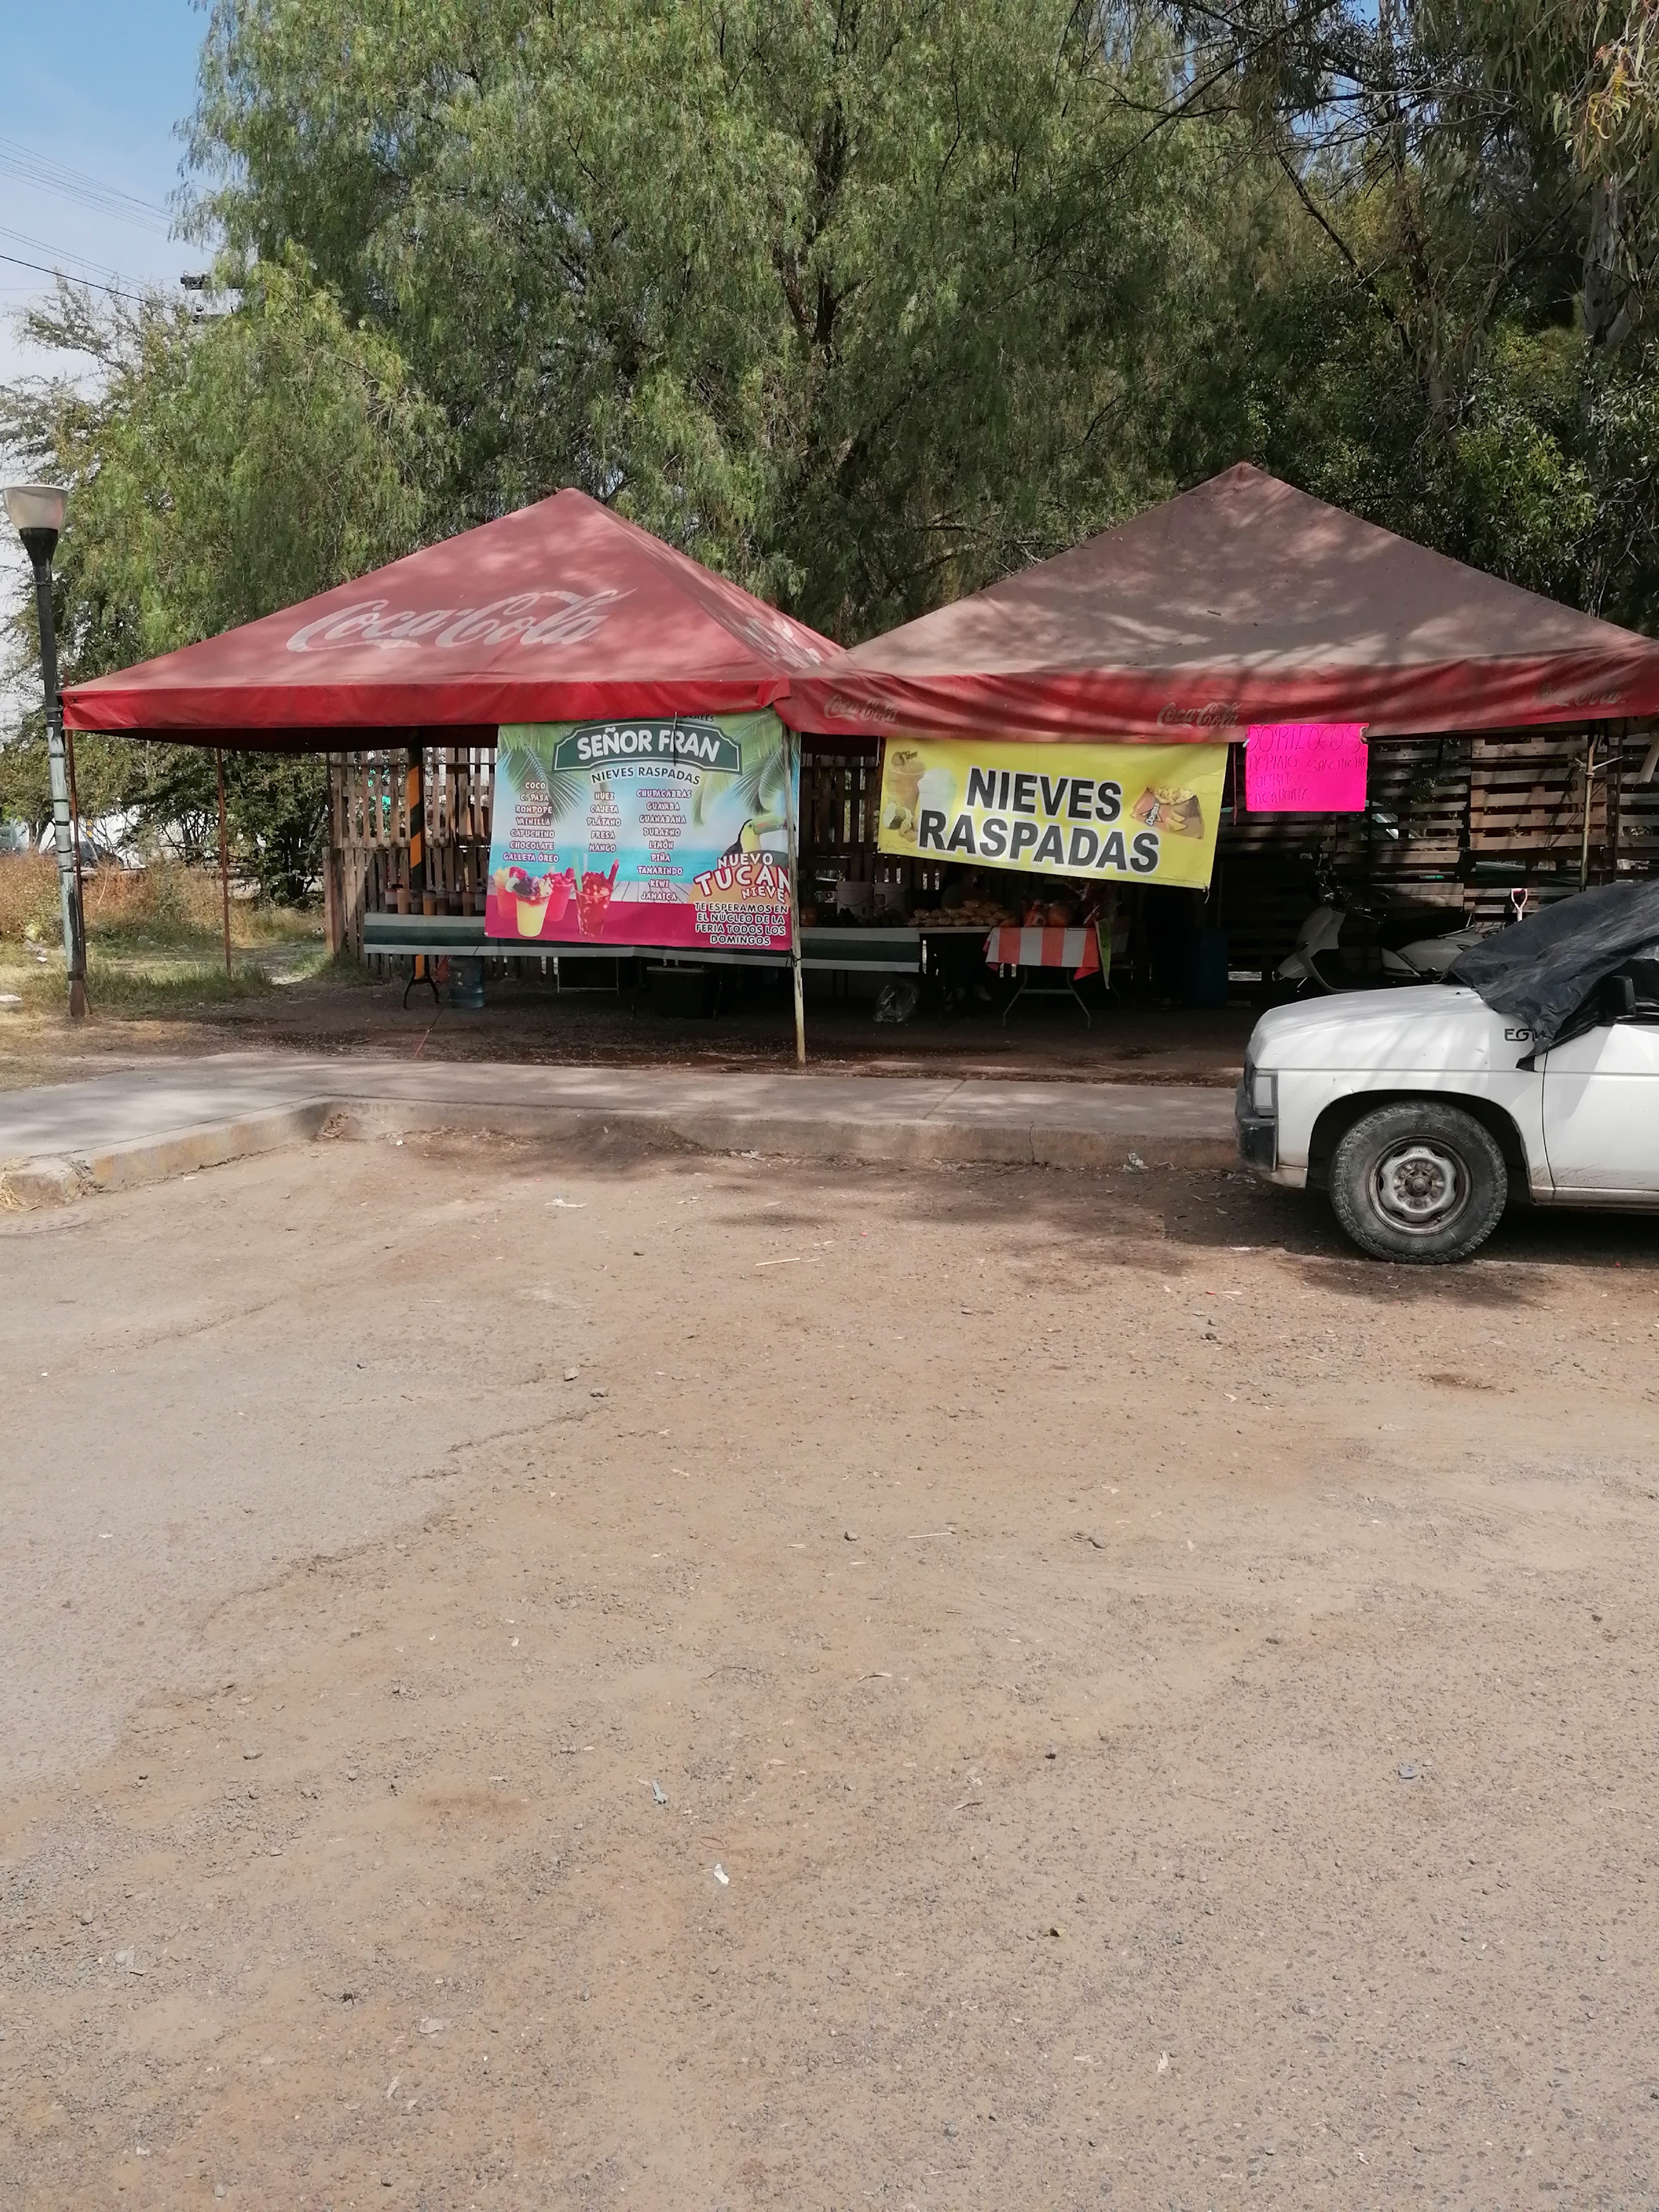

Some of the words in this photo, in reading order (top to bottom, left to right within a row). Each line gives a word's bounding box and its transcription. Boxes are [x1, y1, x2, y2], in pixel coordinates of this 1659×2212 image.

[577, 727, 653, 760] SEÑOR
[658, 729, 721, 763] FRAN
[1248, 725, 1361, 755] DORILOCOS
[592, 766, 634, 784] NIEVES
[638, 766, 701, 785] RASPADAS
[525, 781, 546, 790] COCO
[530, 794, 549, 802] PASA
[594, 791, 615, 801] NUEZ
[636, 789, 692, 798] CHUPACABRAS
[966, 767, 1122, 822] NIEVES
[515, 805, 552, 813] ROMPOPE
[590, 805, 619, 813] CAJETA
[646, 802, 680, 811] GUAYABA
[516, 817, 551, 826] VAINILLA
[587, 816, 621, 827] PLÁTANO
[510, 829, 555, 838] CAPUCHINO
[591, 830, 615, 840] FRESA
[643, 828, 681, 837] DURAZNO
[509, 841, 554, 850] CHOCOLATE
[649, 839, 674, 849] LIMÓN
[918, 809, 1160, 873] RASPADAS
[588, 843, 616, 852] MANGO
[503, 852, 536, 862] GALLETA
[650, 852, 671, 863] PIÑA
[717, 852, 774, 868] NUEVO
[637, 865, 683, 875] TAMARINDO
[649, 879, 670, 888] KIWI
[693, 864, 790, 898] TUCAN
[641, 891, 677, 901] JAMAICA
[741, 885, 786, 904] NIEVE
[695, 902, 706, 911] TE
[709, 903, 771, 913] ESPERAMOS
[774, 905, 788, 914] EN
[697, 913, 708, 922] EL
[711, 912, 753, 923] NÚCLEO
[756, 915, 769, 924] DE
[771, 916, 785, 924] LA
[696, 924, 724, 933] FERIA
[727, 925, 763, 935] TODOS
[765, 926, 786, 935] LOS
[710, 935, 771, 945] DOMINGOS
